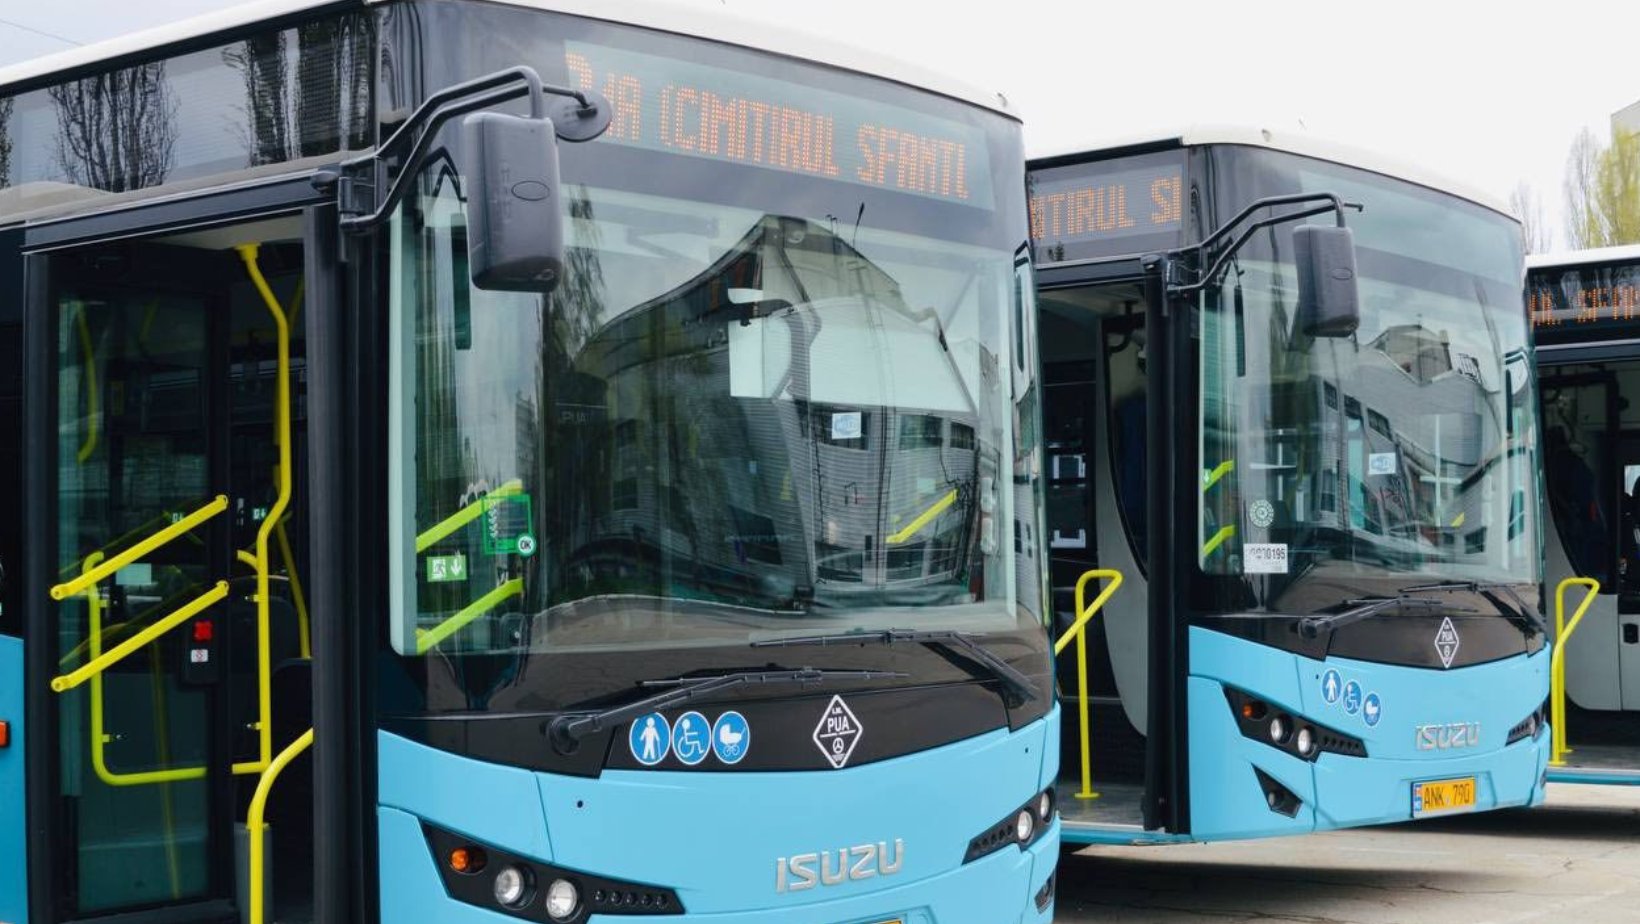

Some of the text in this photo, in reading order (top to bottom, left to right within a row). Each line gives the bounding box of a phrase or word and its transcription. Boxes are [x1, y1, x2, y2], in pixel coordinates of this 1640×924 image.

[660, 81, 840, 174] (CIMITIRUL
[520, 540, 532, 550] OK
[827, 716, 850, 734] PUA
[1416, 722, 1480, 750] ISUZU
[1424, 786, 1444, 808] ANK
[777, 838, 904, 893] ISUZU
